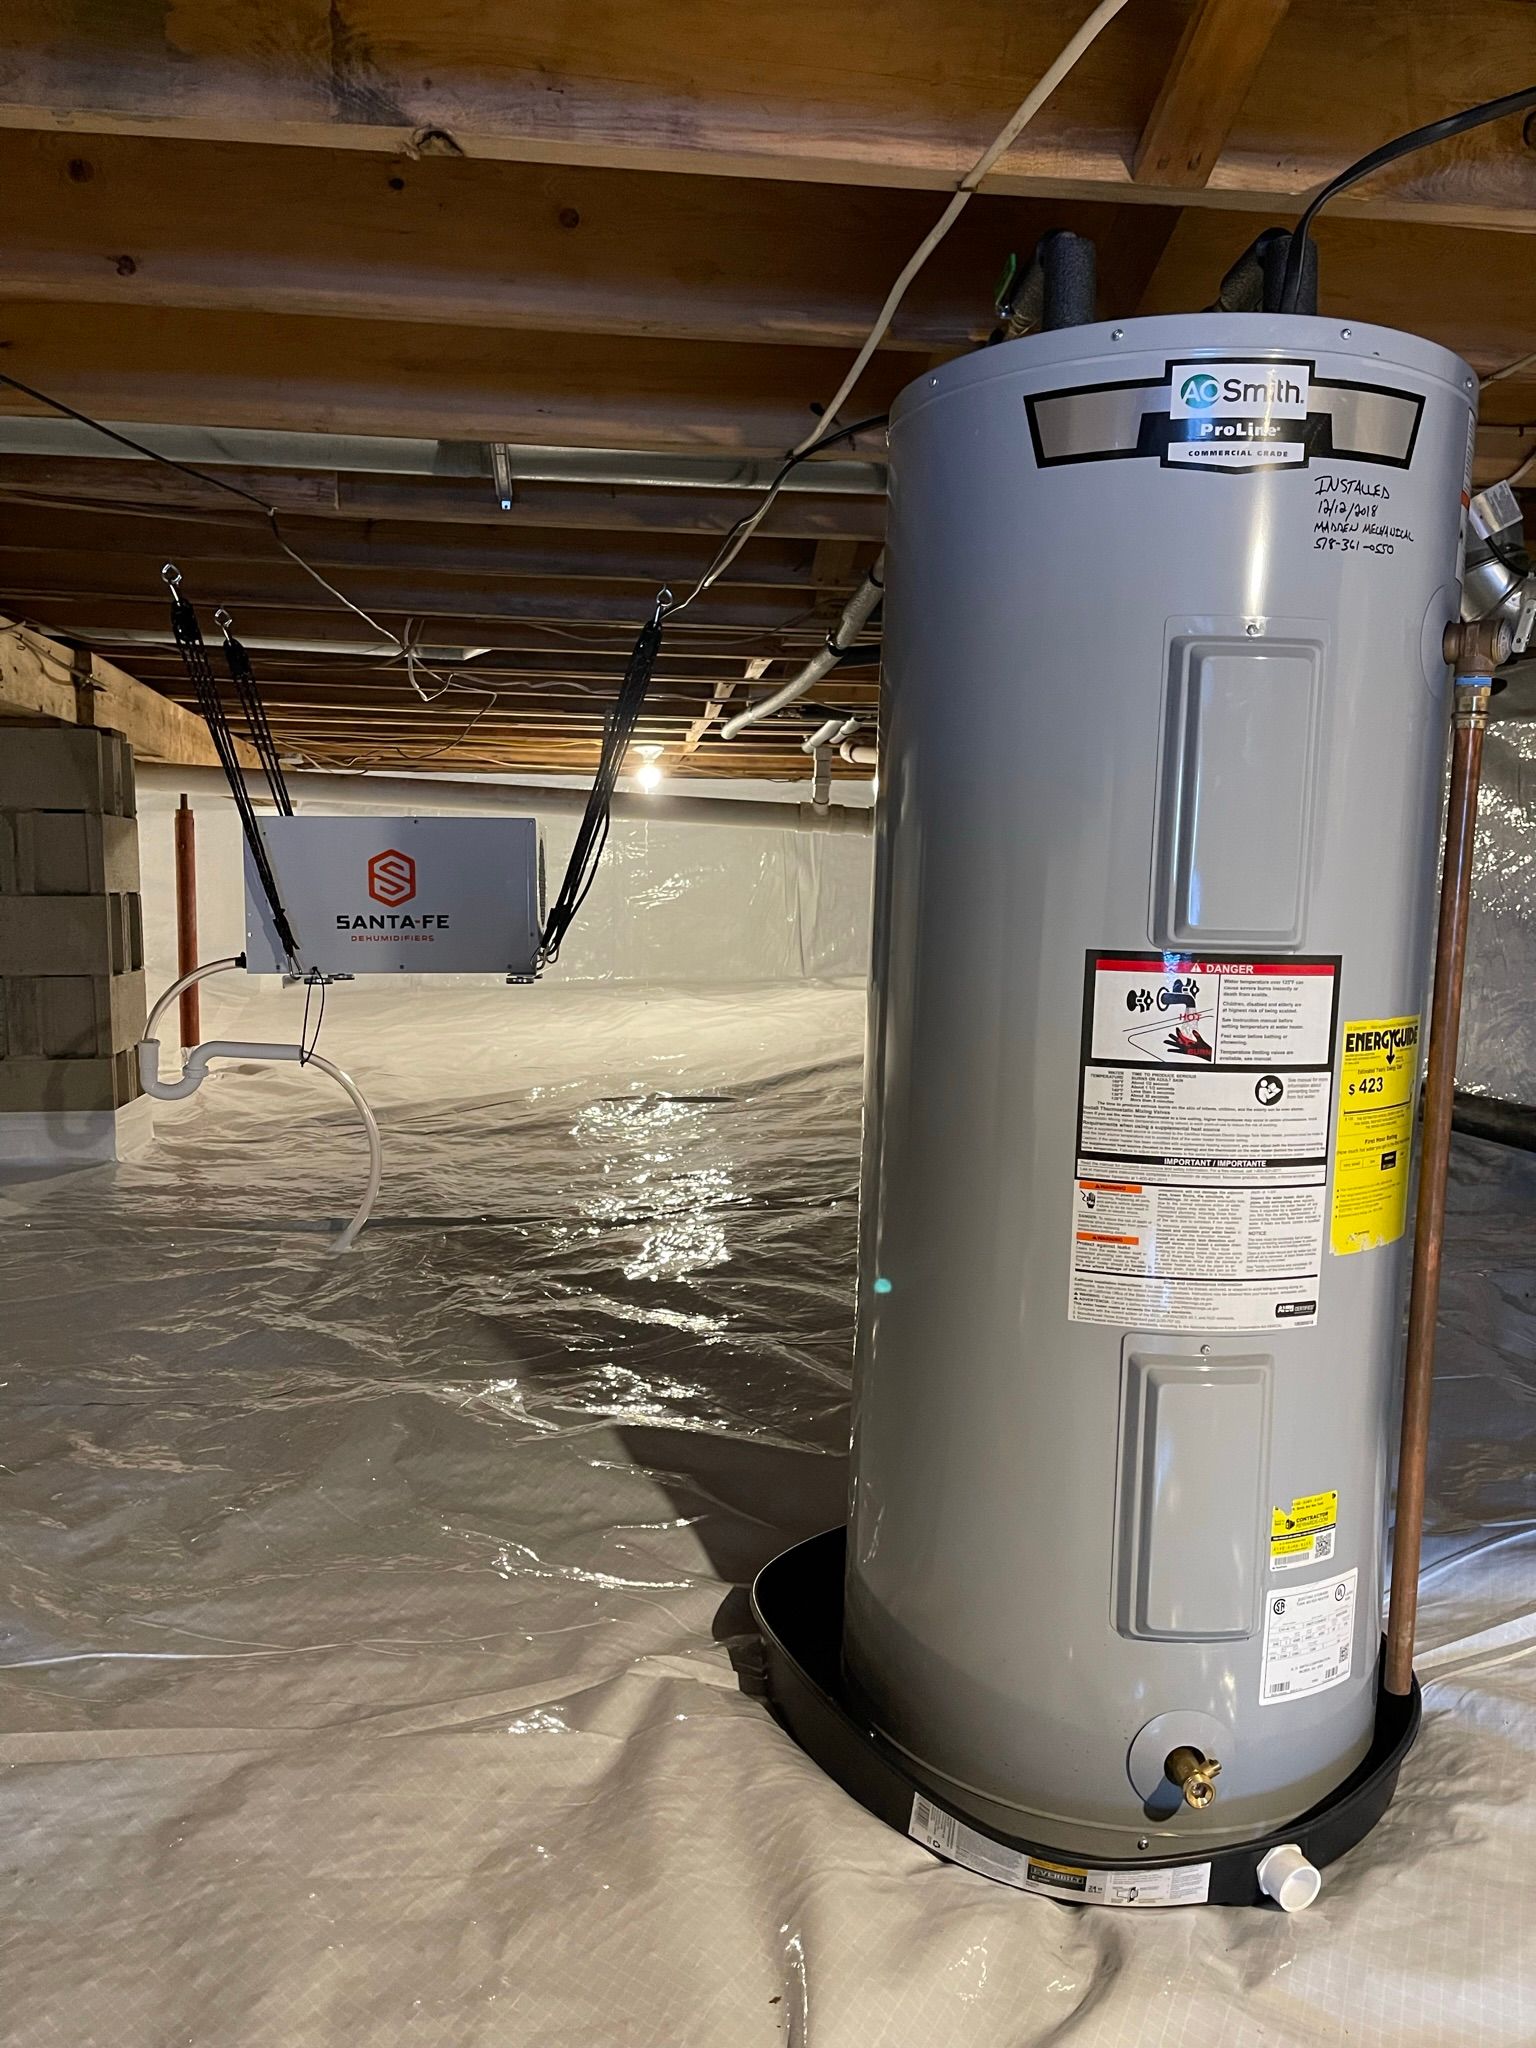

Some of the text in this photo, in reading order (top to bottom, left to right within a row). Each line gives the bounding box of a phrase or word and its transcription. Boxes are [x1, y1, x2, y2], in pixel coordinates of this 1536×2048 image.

[1314, 476, 1390, 499] INSTALLED
[1318, 499, 1378, 522] 12/12/2018
[336, 915, 449, 929] SANTA-FE
[1206, 965, 1254, 974] DANGER
[1349, 1077, 1383, 1096] $ 423
[1164, 1158, 1210, 1167] IMPORTANT
